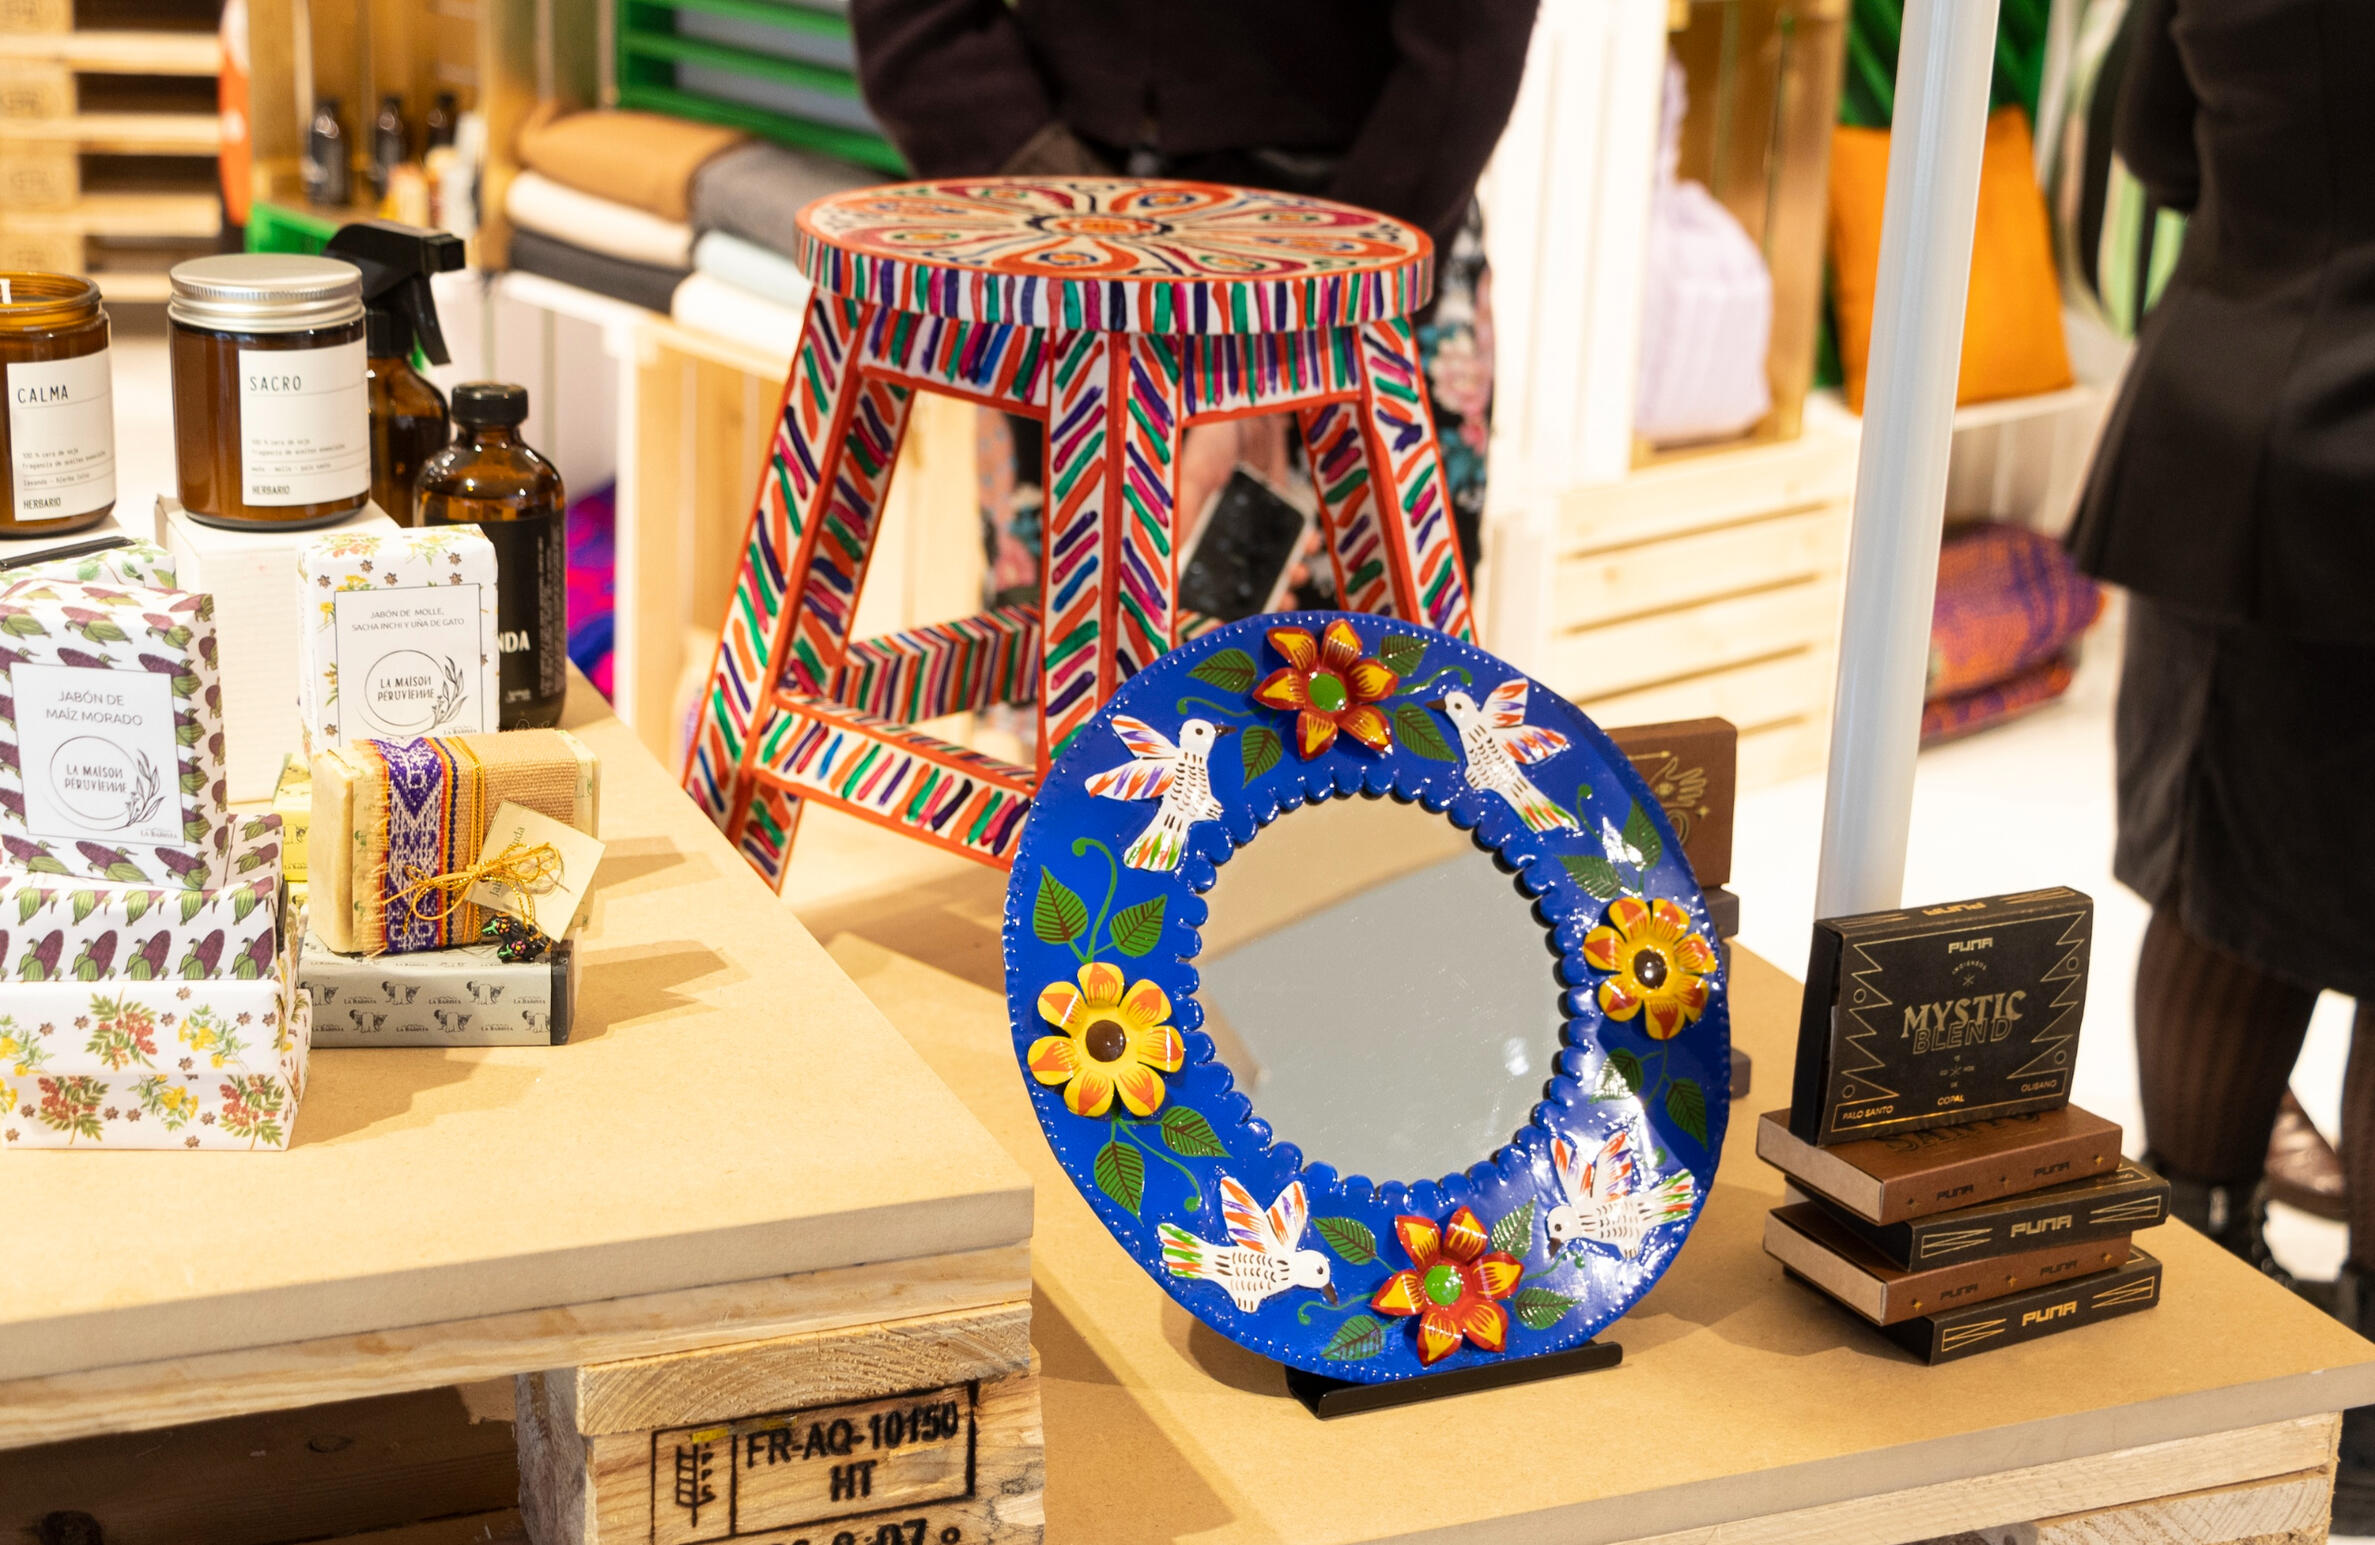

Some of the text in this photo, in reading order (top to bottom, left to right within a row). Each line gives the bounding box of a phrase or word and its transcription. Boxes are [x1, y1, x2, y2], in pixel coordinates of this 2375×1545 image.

[250, 376, 302, 392] SACRO
[18, 384, 69, 404] CALMA
[252, 485, 290, 495] HERBARIO
[23, 497, 62, 510] HERBARIO
[370, 608, 398, 619] JABÓN
[400, 609, 411, 617] DE
[352, 623, 379, 632] SACHA
[380, 622, 403, 630] INCHI
[411, 619, 429, 628] UÑA
[430, 619, 441, 627] DE
[442, 617, 465, 626] GATO
[380, 678, 392, 689] LA
[58, 690, 125, 706] JABÓN DE
[46, 707, 143, 726] MAÍZ MORADO
[66, 763, 79, 776] LA
[1948, 937, 1993, 954] PUNA
[1901, 989, 2027, 1039] MYSTIC
[1912, 1017, 2013, 1055] BLEND
[1937, 1094, 1965, 1106] COPAL
[1842, 1104, 1895, 1121] PALO SANTO
[1936, 1161, 2070, 1200] PUNA PUNA
[2010, 1215, 2073, 1238] PUNA
[1940, 1260, 2078, 1300] PUNA PUNA
[2022, 1300, 2078, 1327] PUNA
[747, 1400, 959, 1469] FR-AQ-10150
[830, 1459, 879, 1502] HT
